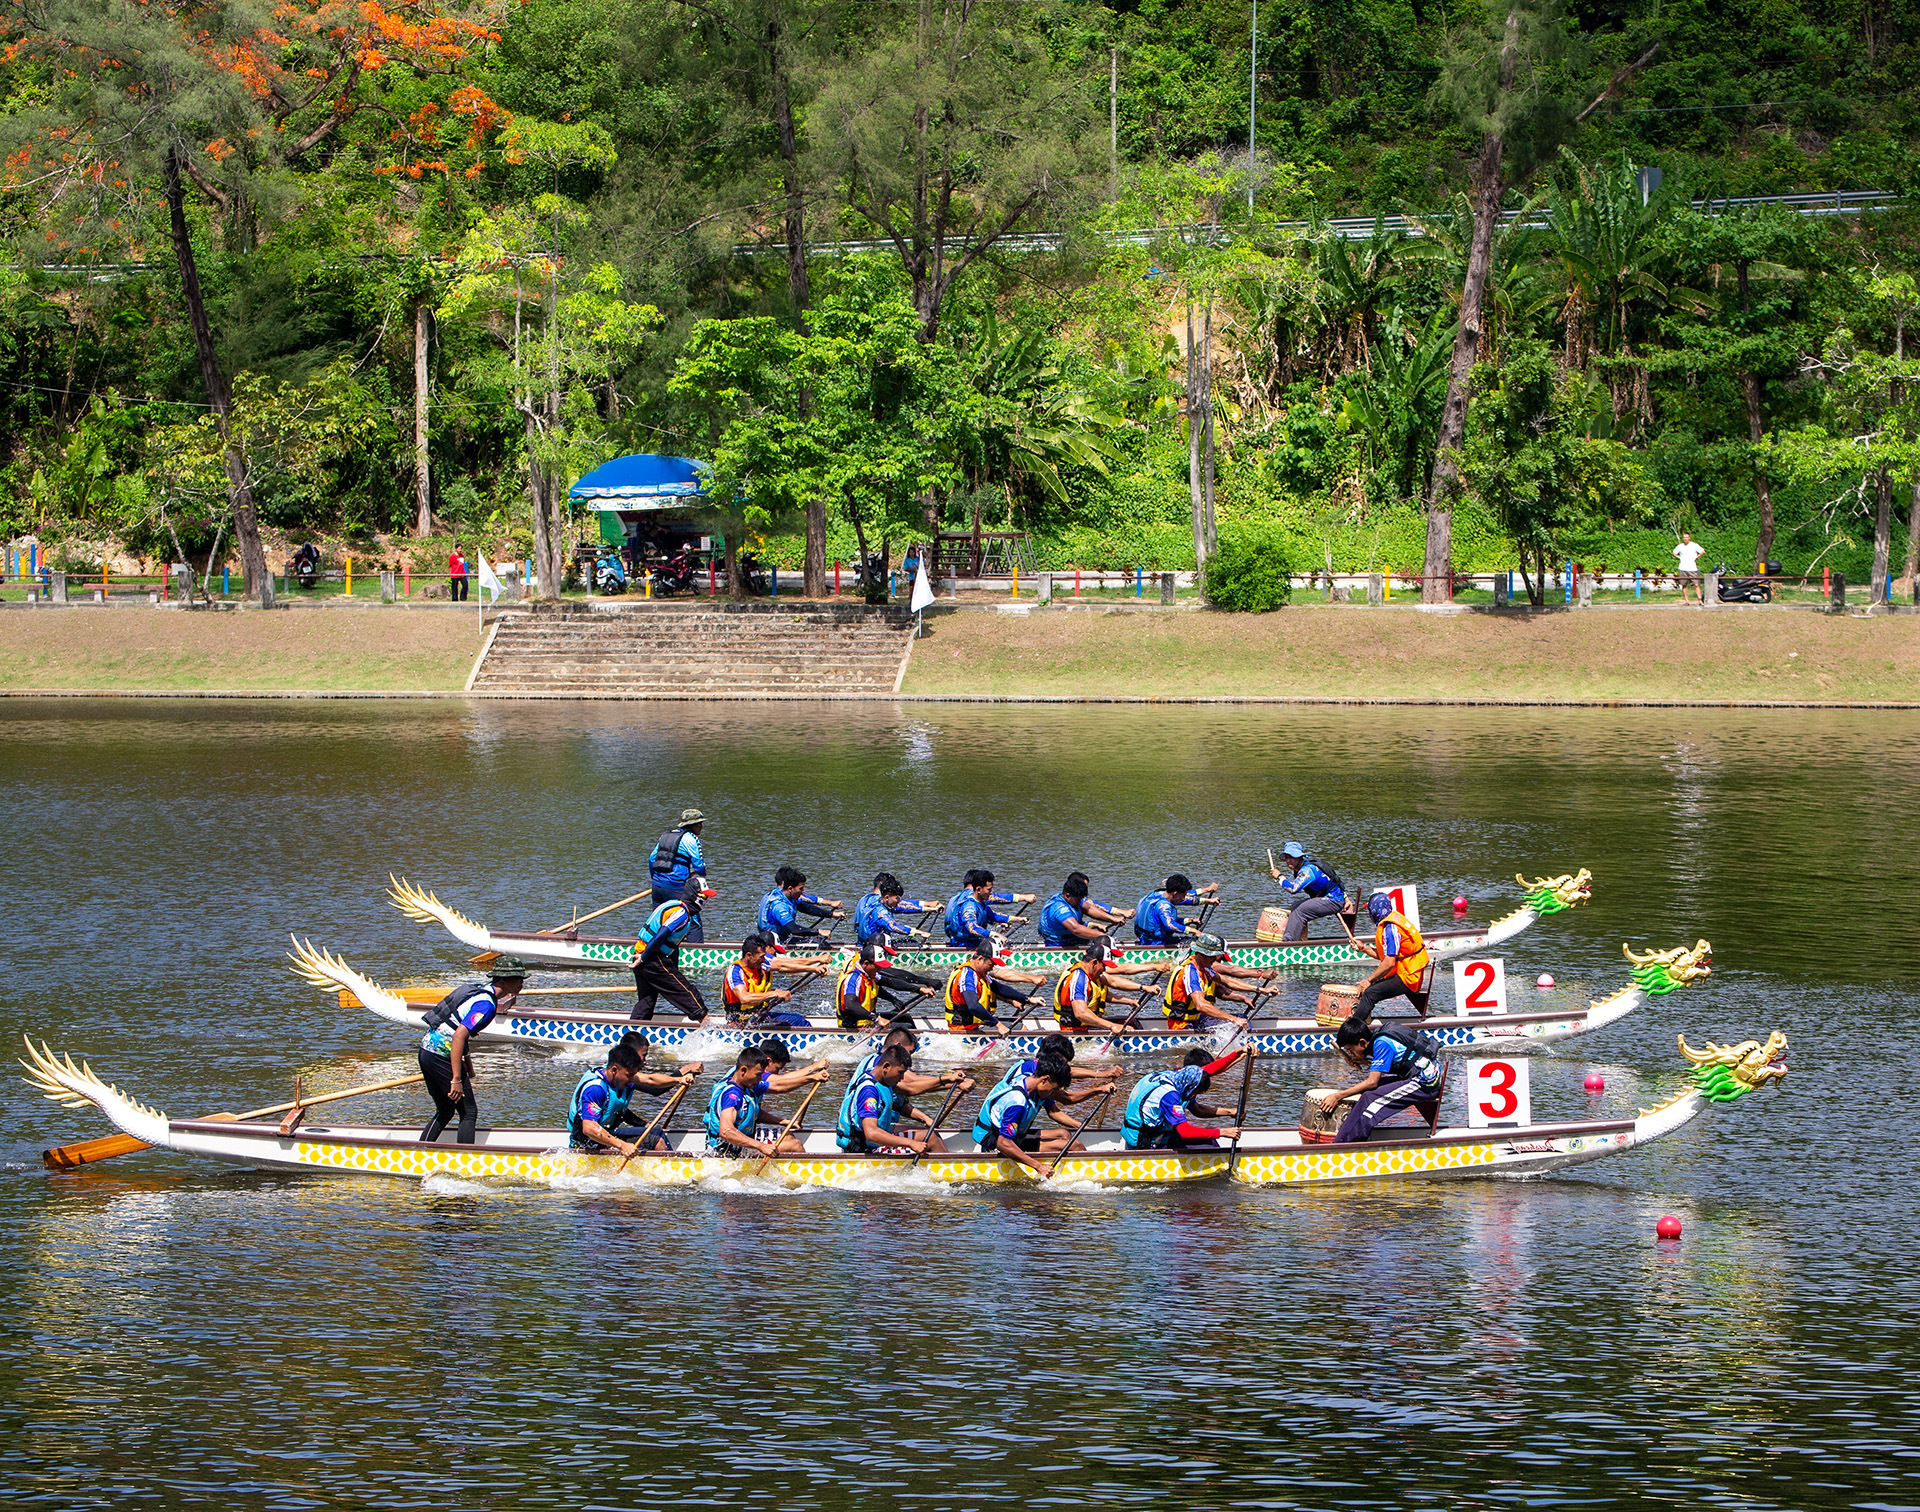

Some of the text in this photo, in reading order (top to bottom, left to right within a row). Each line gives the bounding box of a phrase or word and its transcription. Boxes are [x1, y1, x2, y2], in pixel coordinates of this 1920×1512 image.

[1387, 888, 1405, 917] 1
[1464, 962, 1498, 1009] 2
[1479, 1062, 1518, 1118] 3
